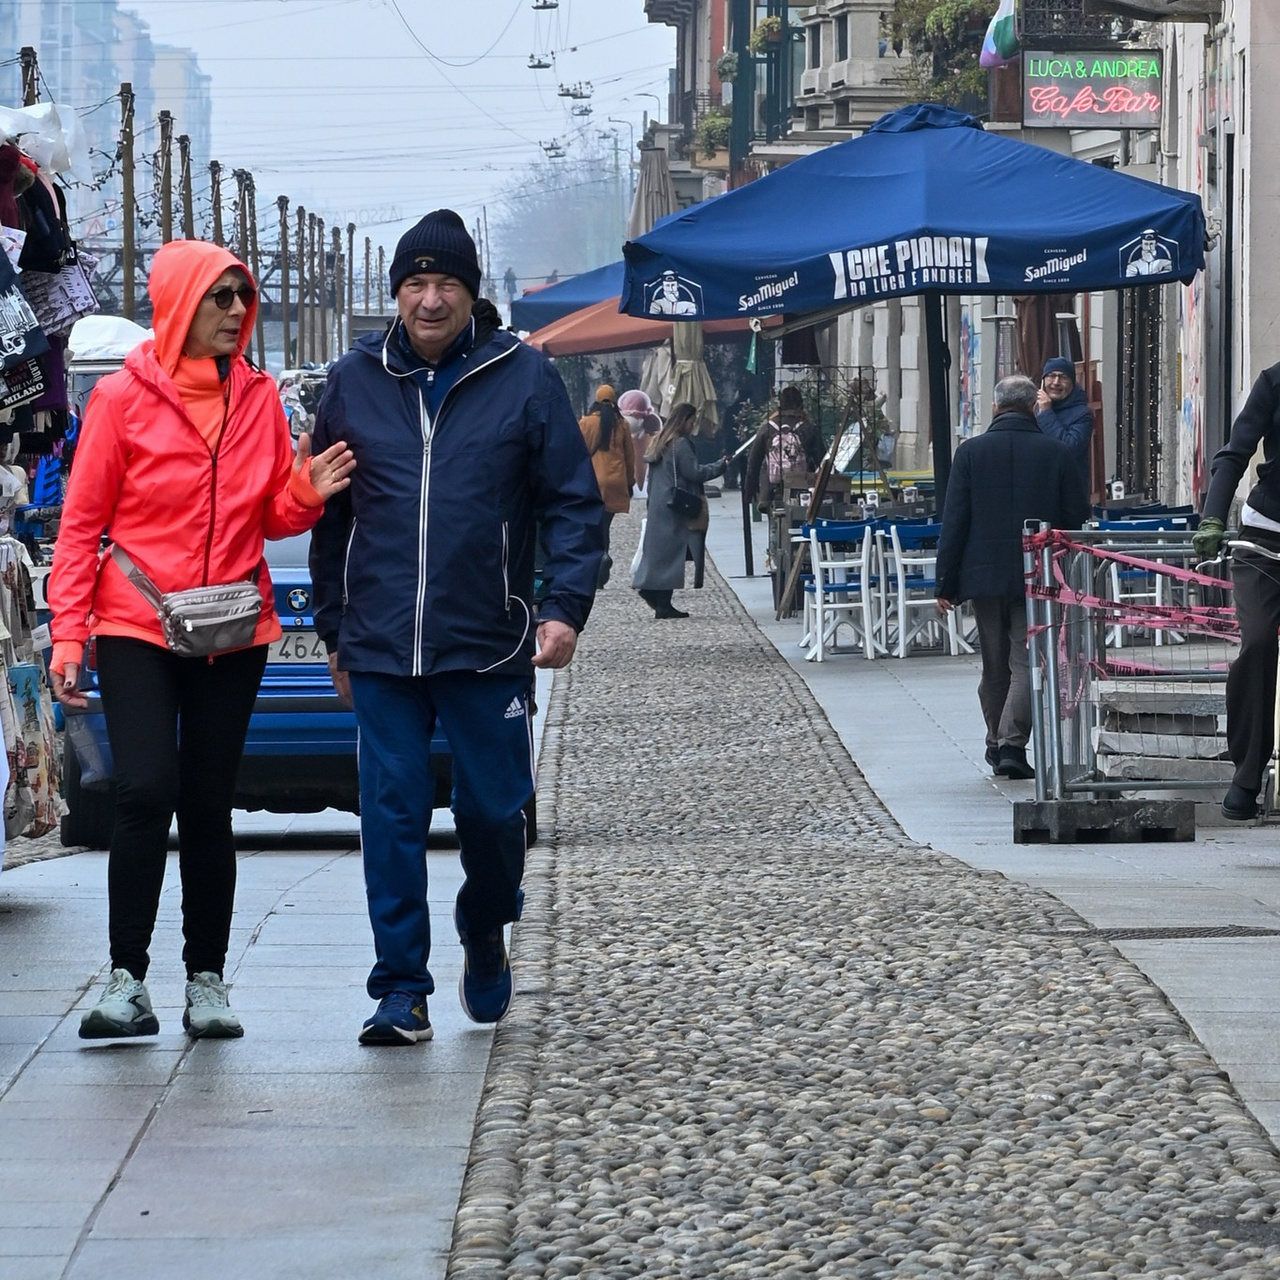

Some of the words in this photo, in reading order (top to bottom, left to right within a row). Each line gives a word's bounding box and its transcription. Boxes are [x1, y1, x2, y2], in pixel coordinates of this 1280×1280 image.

[1027, 59, 1073, 79] LUCA
[1075, 60, 1088, 78] &
[1090, 59, 1160, 78] ANDREA
[1093, 86, 1161, 114] Bar
[847, 245, 891, 281] CHE
[895, 237, 972, 272] PIADA!
[850, 280, 867, 297] DA
[873, 274, 906, 294] LUCA
[911, 271, 918, 286] E
[922, 268, 972, 284] ANDREA
[3, 382, 44, 406] MILANO
